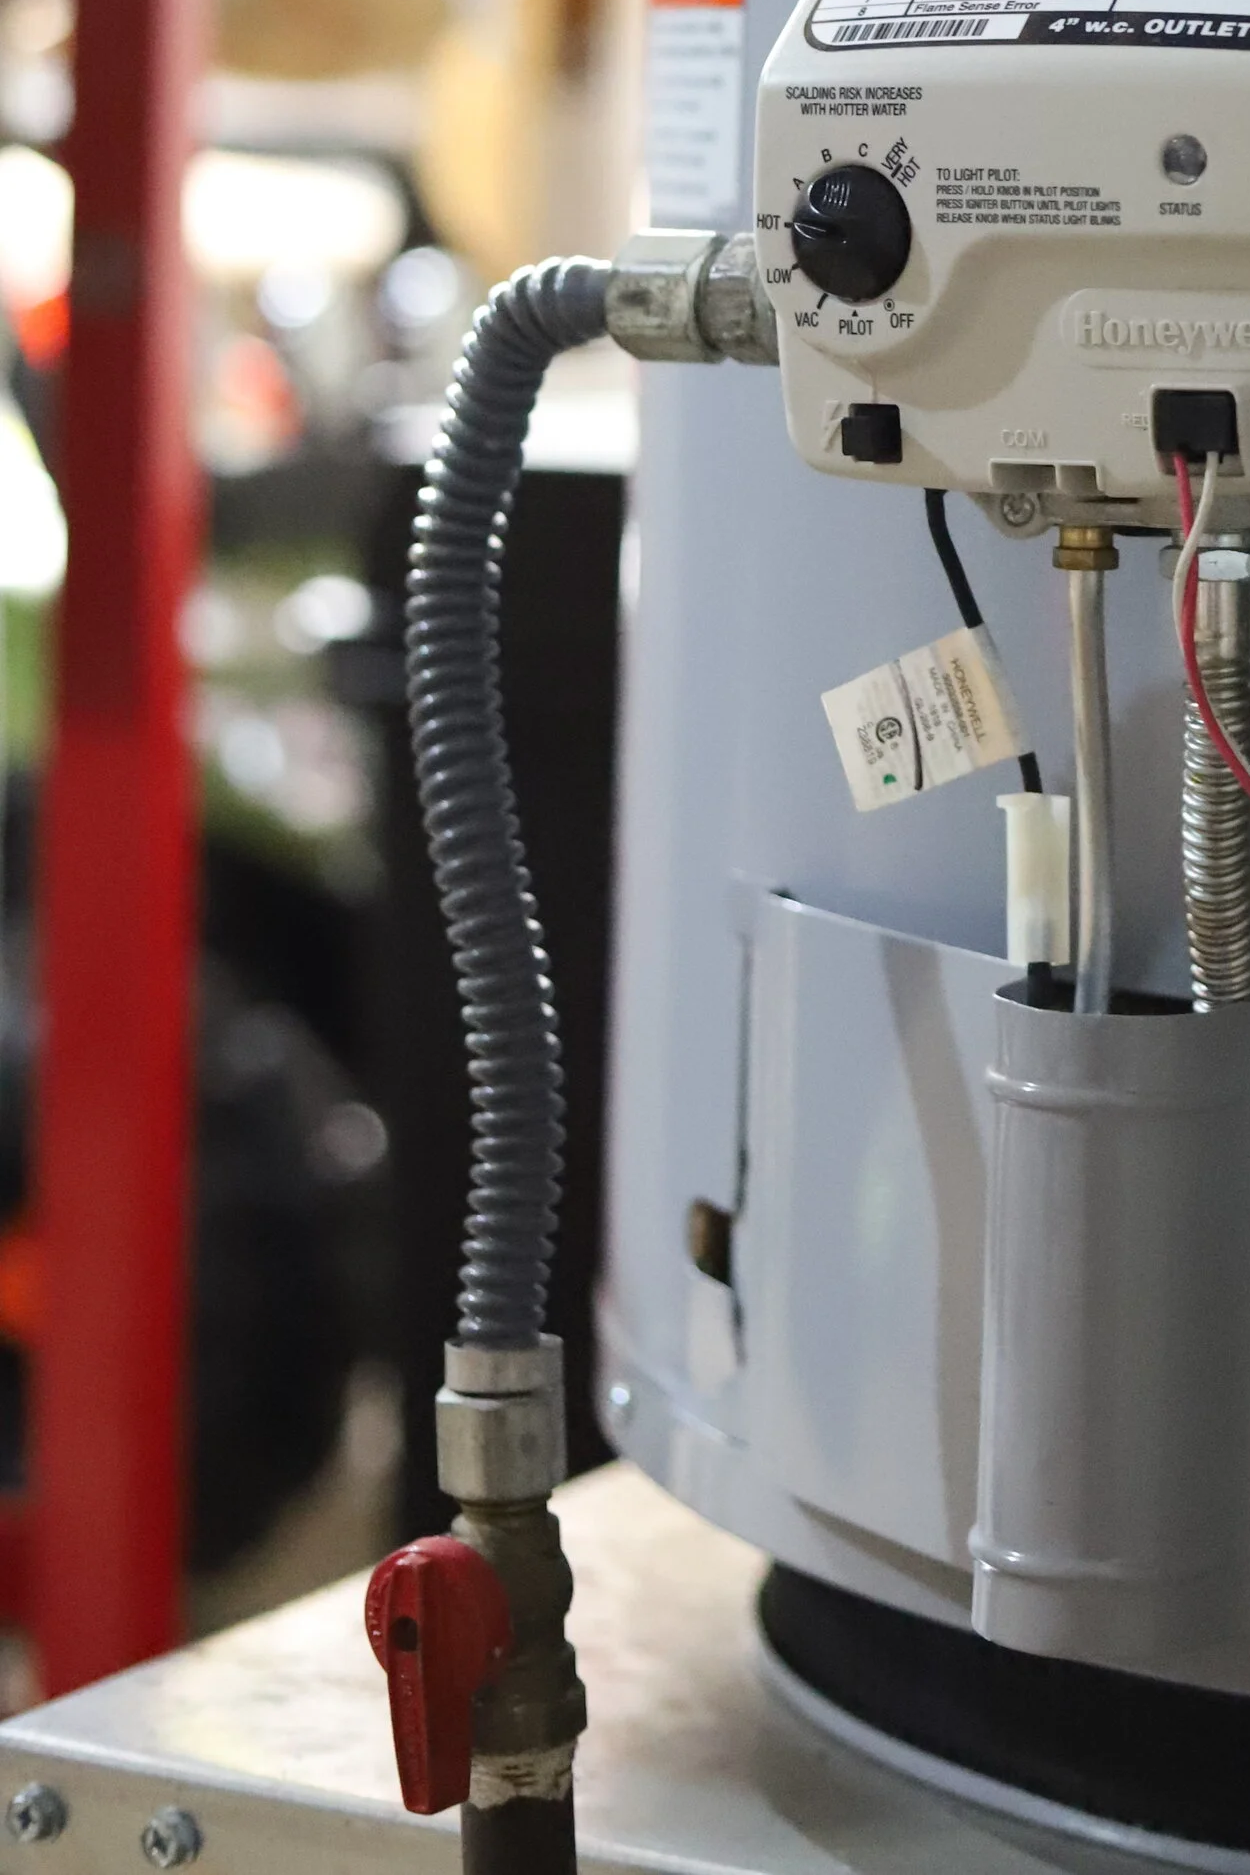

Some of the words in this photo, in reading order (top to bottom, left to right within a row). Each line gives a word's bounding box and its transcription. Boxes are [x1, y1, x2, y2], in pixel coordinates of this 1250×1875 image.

[857, 7, 868, 16] 8
[913, 3, 958, 13] Flame
[961, 2, 1001, 11] Sense
[1004, 1, 1040, 11] Error
[1084, 21, 1134, 33] w.c.
[785, 87, 836, 100] SCALDING
[839, 87, 862, 99] RISK
[865, 87, 923, 100] INCREASES
[801, 103, 826, 115] WITH
[829, 103, 869, 116] HOTTER
[872, 103, 907, 116] WATER
[821, 148, 832, 163] B
[858, 142, 869, 158] C
[881, 136, 909, 172] VERY
[898, 156, 921, 188] HOT
[936, 169, 951, 181] TO
[954, 169, 984, 182] LIGHT
[987, 169, 1021, 182] PILOT:
[792, 177, 804, 191] A
[936, 185, 964, 196] PRESS
[971, 186, 994, 196] HOLD
[997, 186, 1021, 196] KNOB
[1023, 187, 1031, 197] IN
[1034, 186, 1057, 197] PILOT
[1060, 186, 1100, 198] POSITION
[936, 200, 964, 210] PRESS
[966, 200, 998, 210] IGNITER
[1000, 200, 1035, 210] BUTTON
[1037, 200, 1062, 211] UNTIL
[1063, 200, 1089, 211] PILOT
[1090, 201, 1121, 212] LIGHTS
[1159, 202, 1202, 215] STATUS
[757, 214, 781, 230] HOT
[936, 213, 972, 224] RELEASE
[975, 214, 999, 224] KNOB
[1001, 214, 1026, 224] WHEN
[1029, 214, 1061, 225] STATUS
[1062, 215, 1088, 225] LIGHT
[766, 268, 793, 284] LOW
[794, 312, 820, 327] VAC
[890, 313, 915, 329] OFF
[838, 319, 874, 336] PILOT
[1001, 429, 1047, 448] COM
